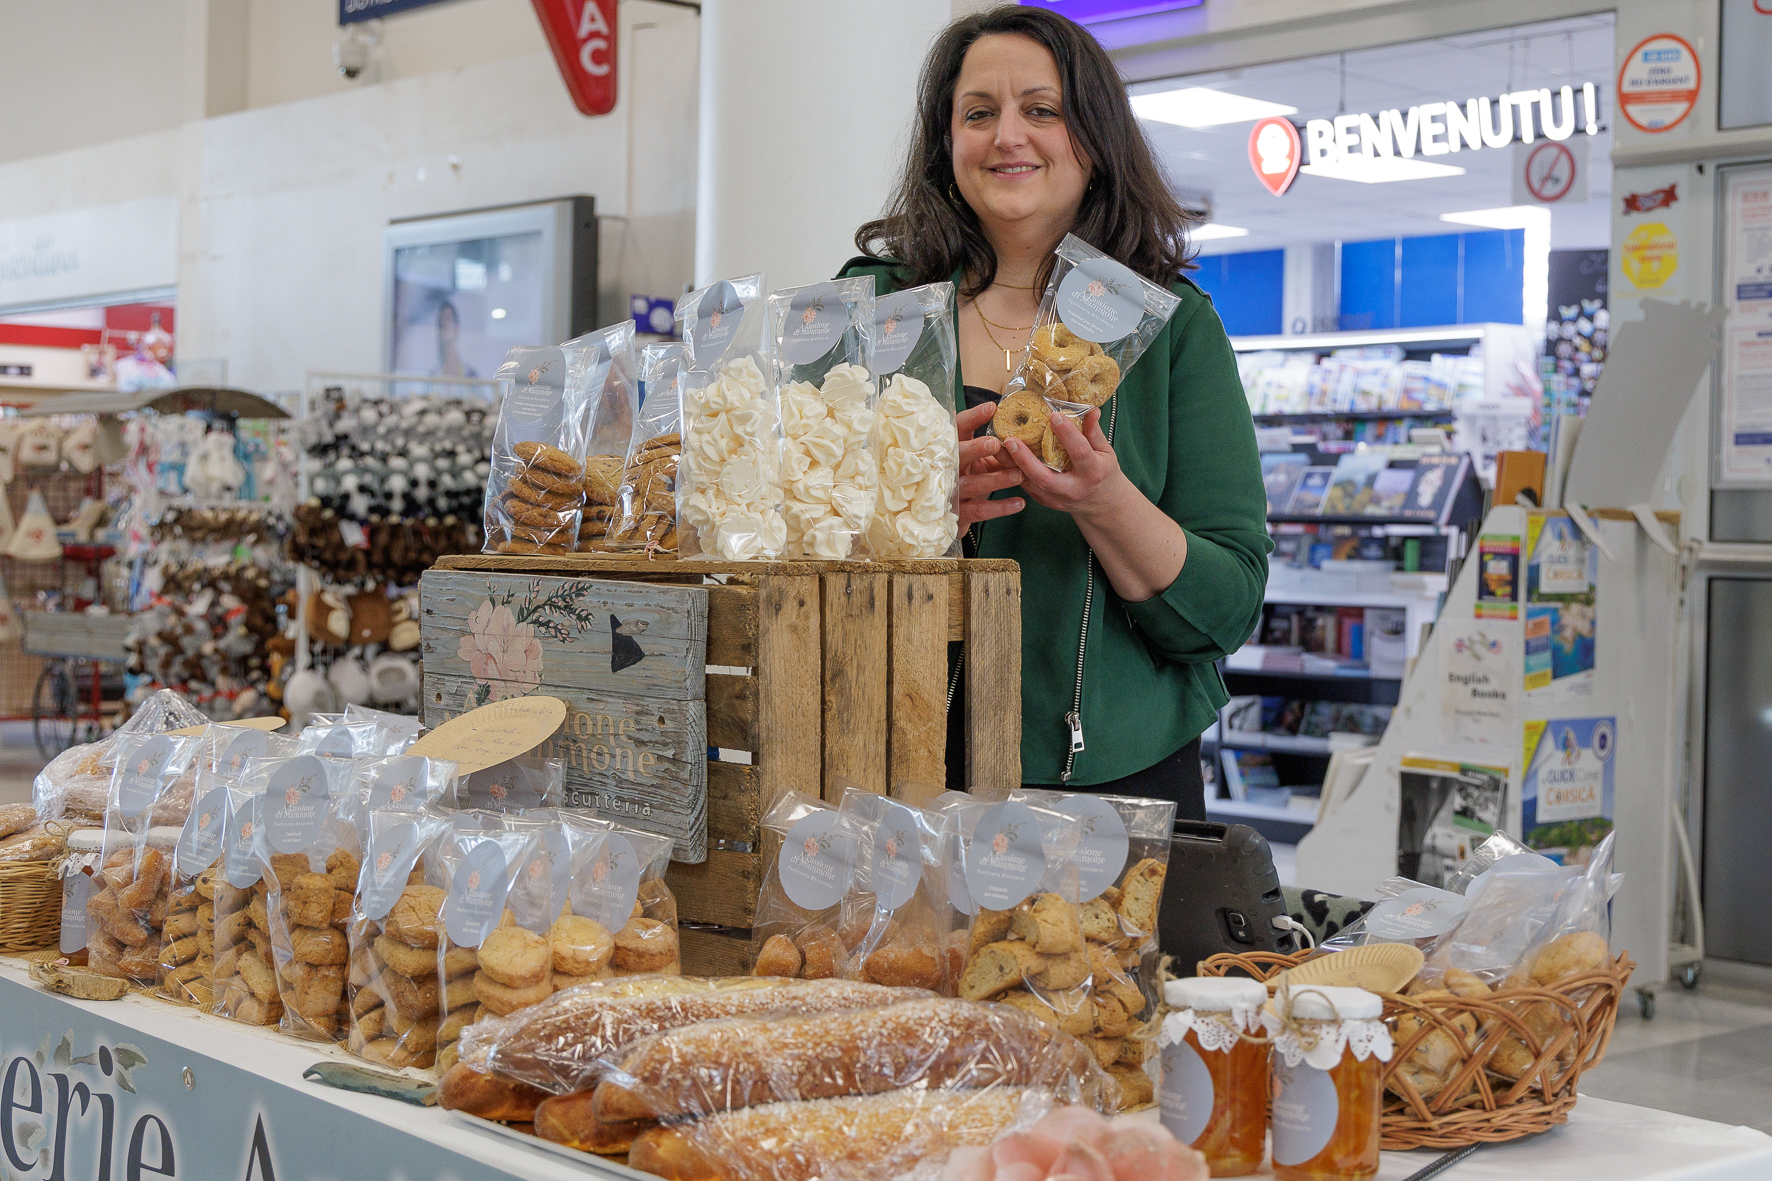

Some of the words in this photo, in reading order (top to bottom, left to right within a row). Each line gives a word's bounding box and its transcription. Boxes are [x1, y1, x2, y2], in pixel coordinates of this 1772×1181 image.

[1448, 672, 1490, 686] English
[1471, 687, 1507, 700] Books
[565, 700, 637, 746] ione
[563, 791, 652, 817] scutterià
[1544, 784, 1597, 807] CORSICA
[806, 853, 835, 873] Passione
